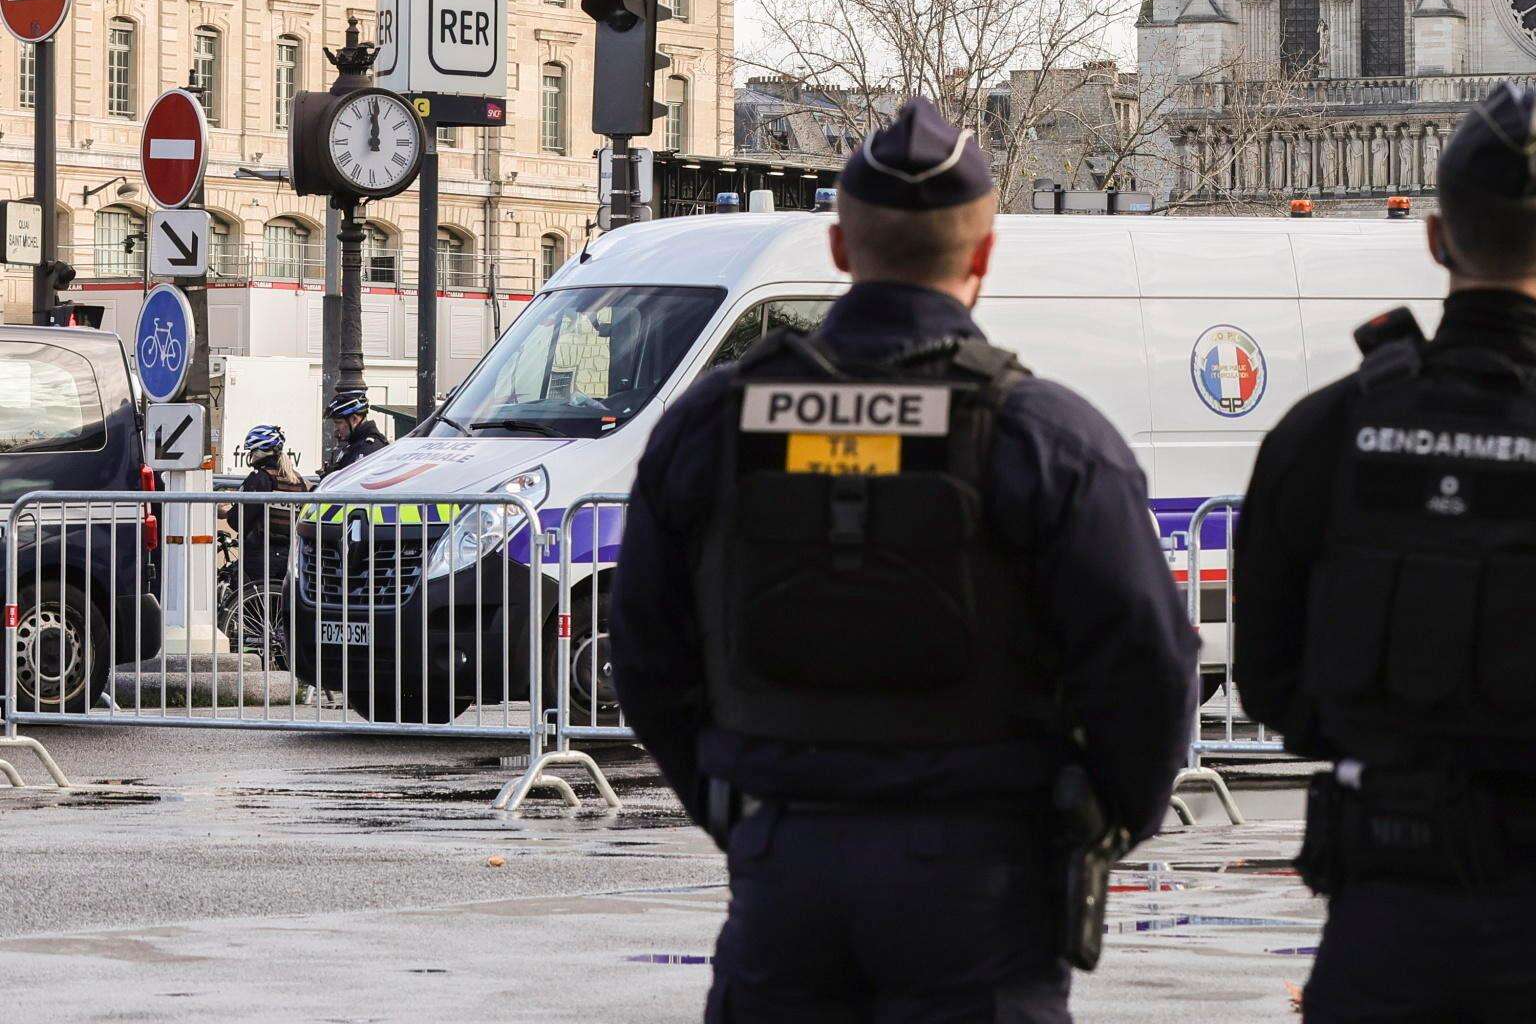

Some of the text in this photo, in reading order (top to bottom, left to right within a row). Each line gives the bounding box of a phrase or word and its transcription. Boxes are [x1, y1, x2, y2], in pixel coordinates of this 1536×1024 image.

[377, 10, 393, 45] ER
[440, 8, 490, 47] RER
[417, 102, 425, 113] C
[487, 109, 503, 118] SNCF
[767, 391, 923, 426] POLICE
